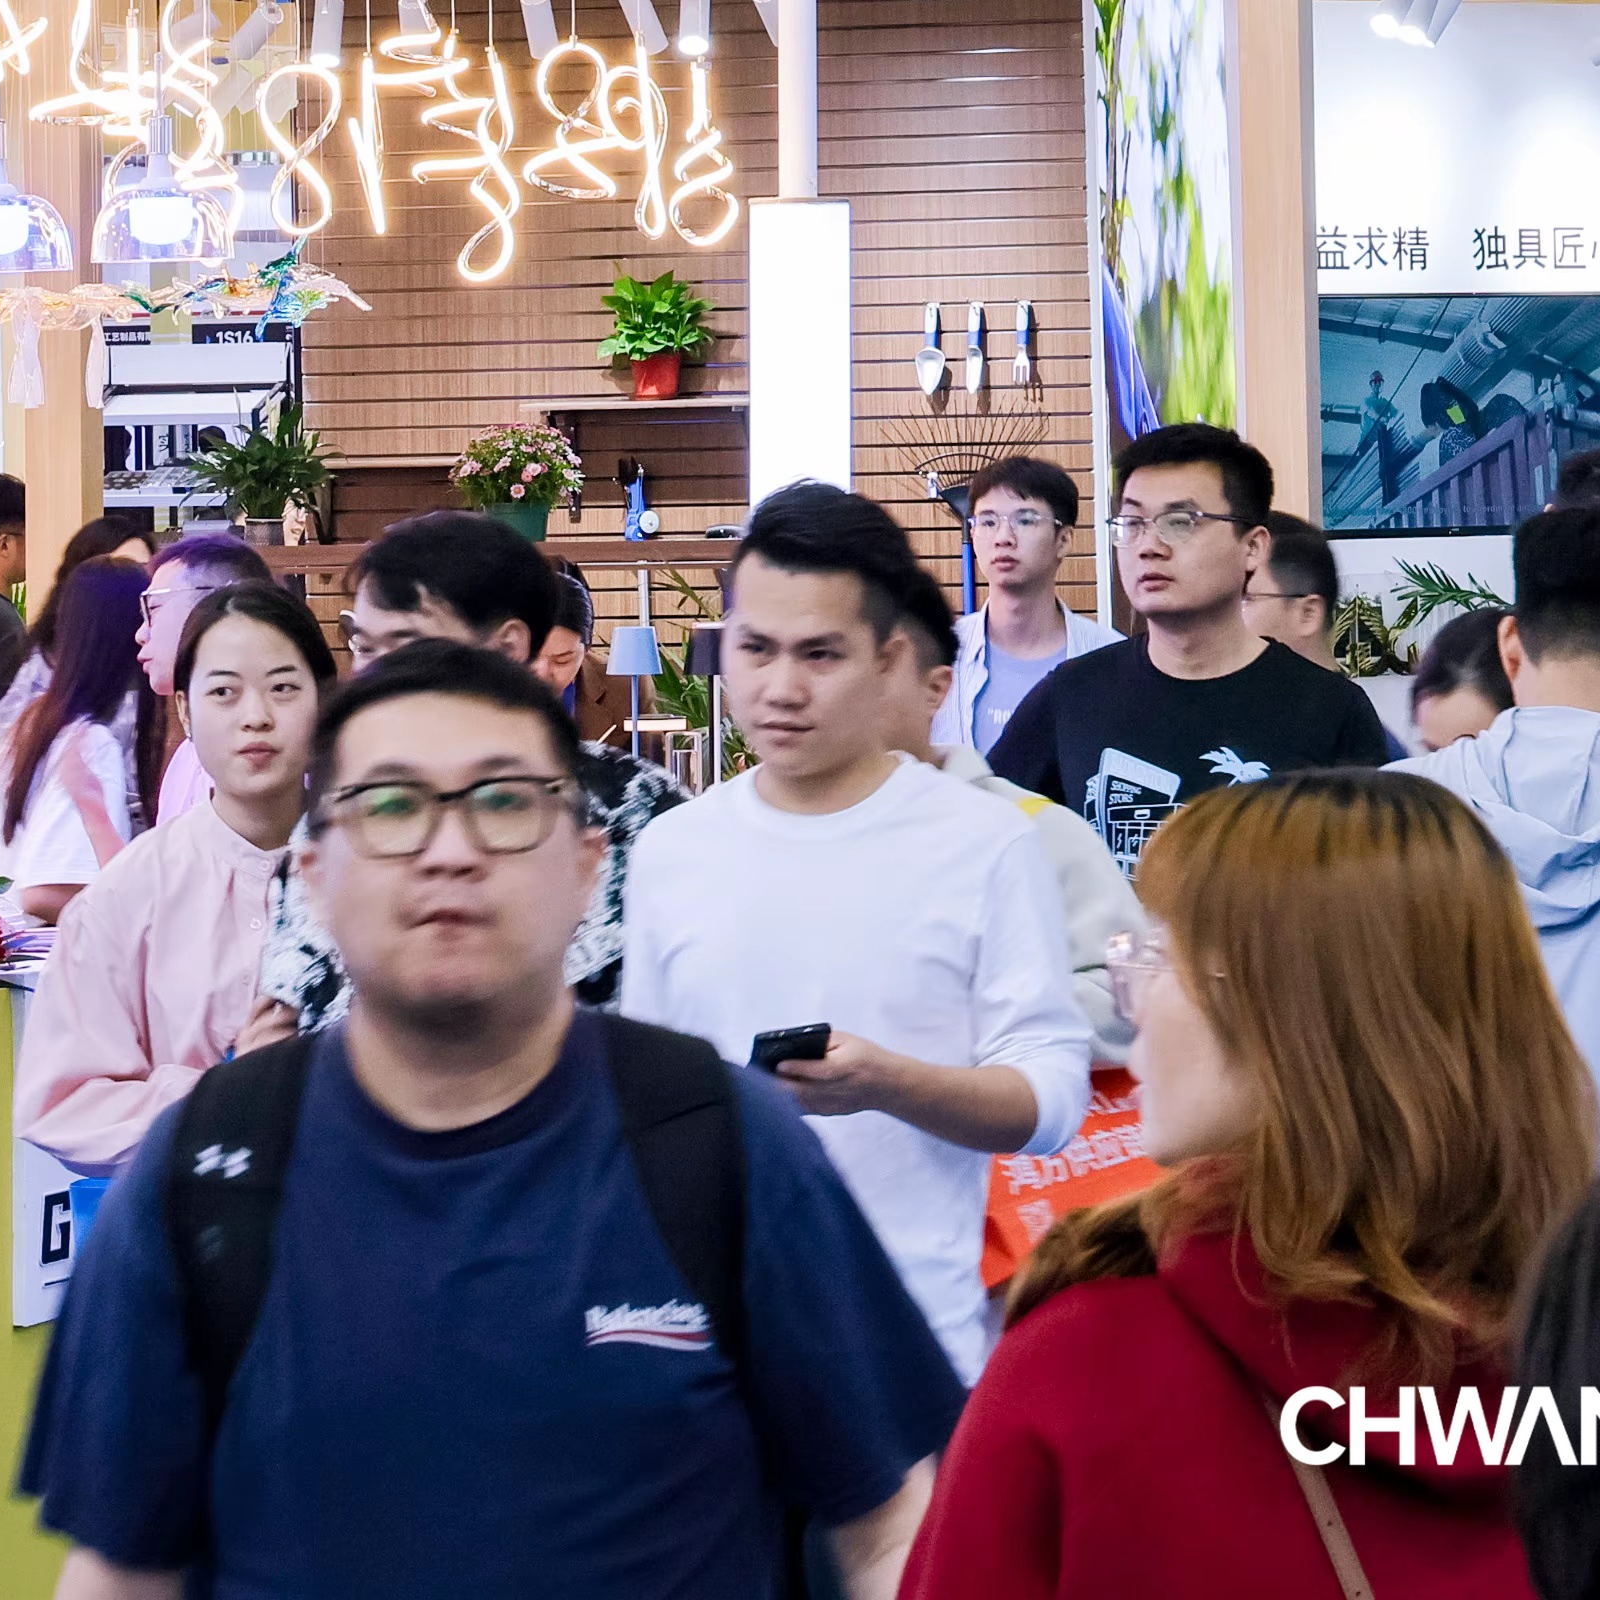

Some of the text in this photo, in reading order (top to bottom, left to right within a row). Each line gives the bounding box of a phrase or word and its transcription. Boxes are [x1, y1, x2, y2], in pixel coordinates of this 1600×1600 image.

[1315, 226, 1430, 272] 益求精
[216, 330, 254, 344] 1S16
